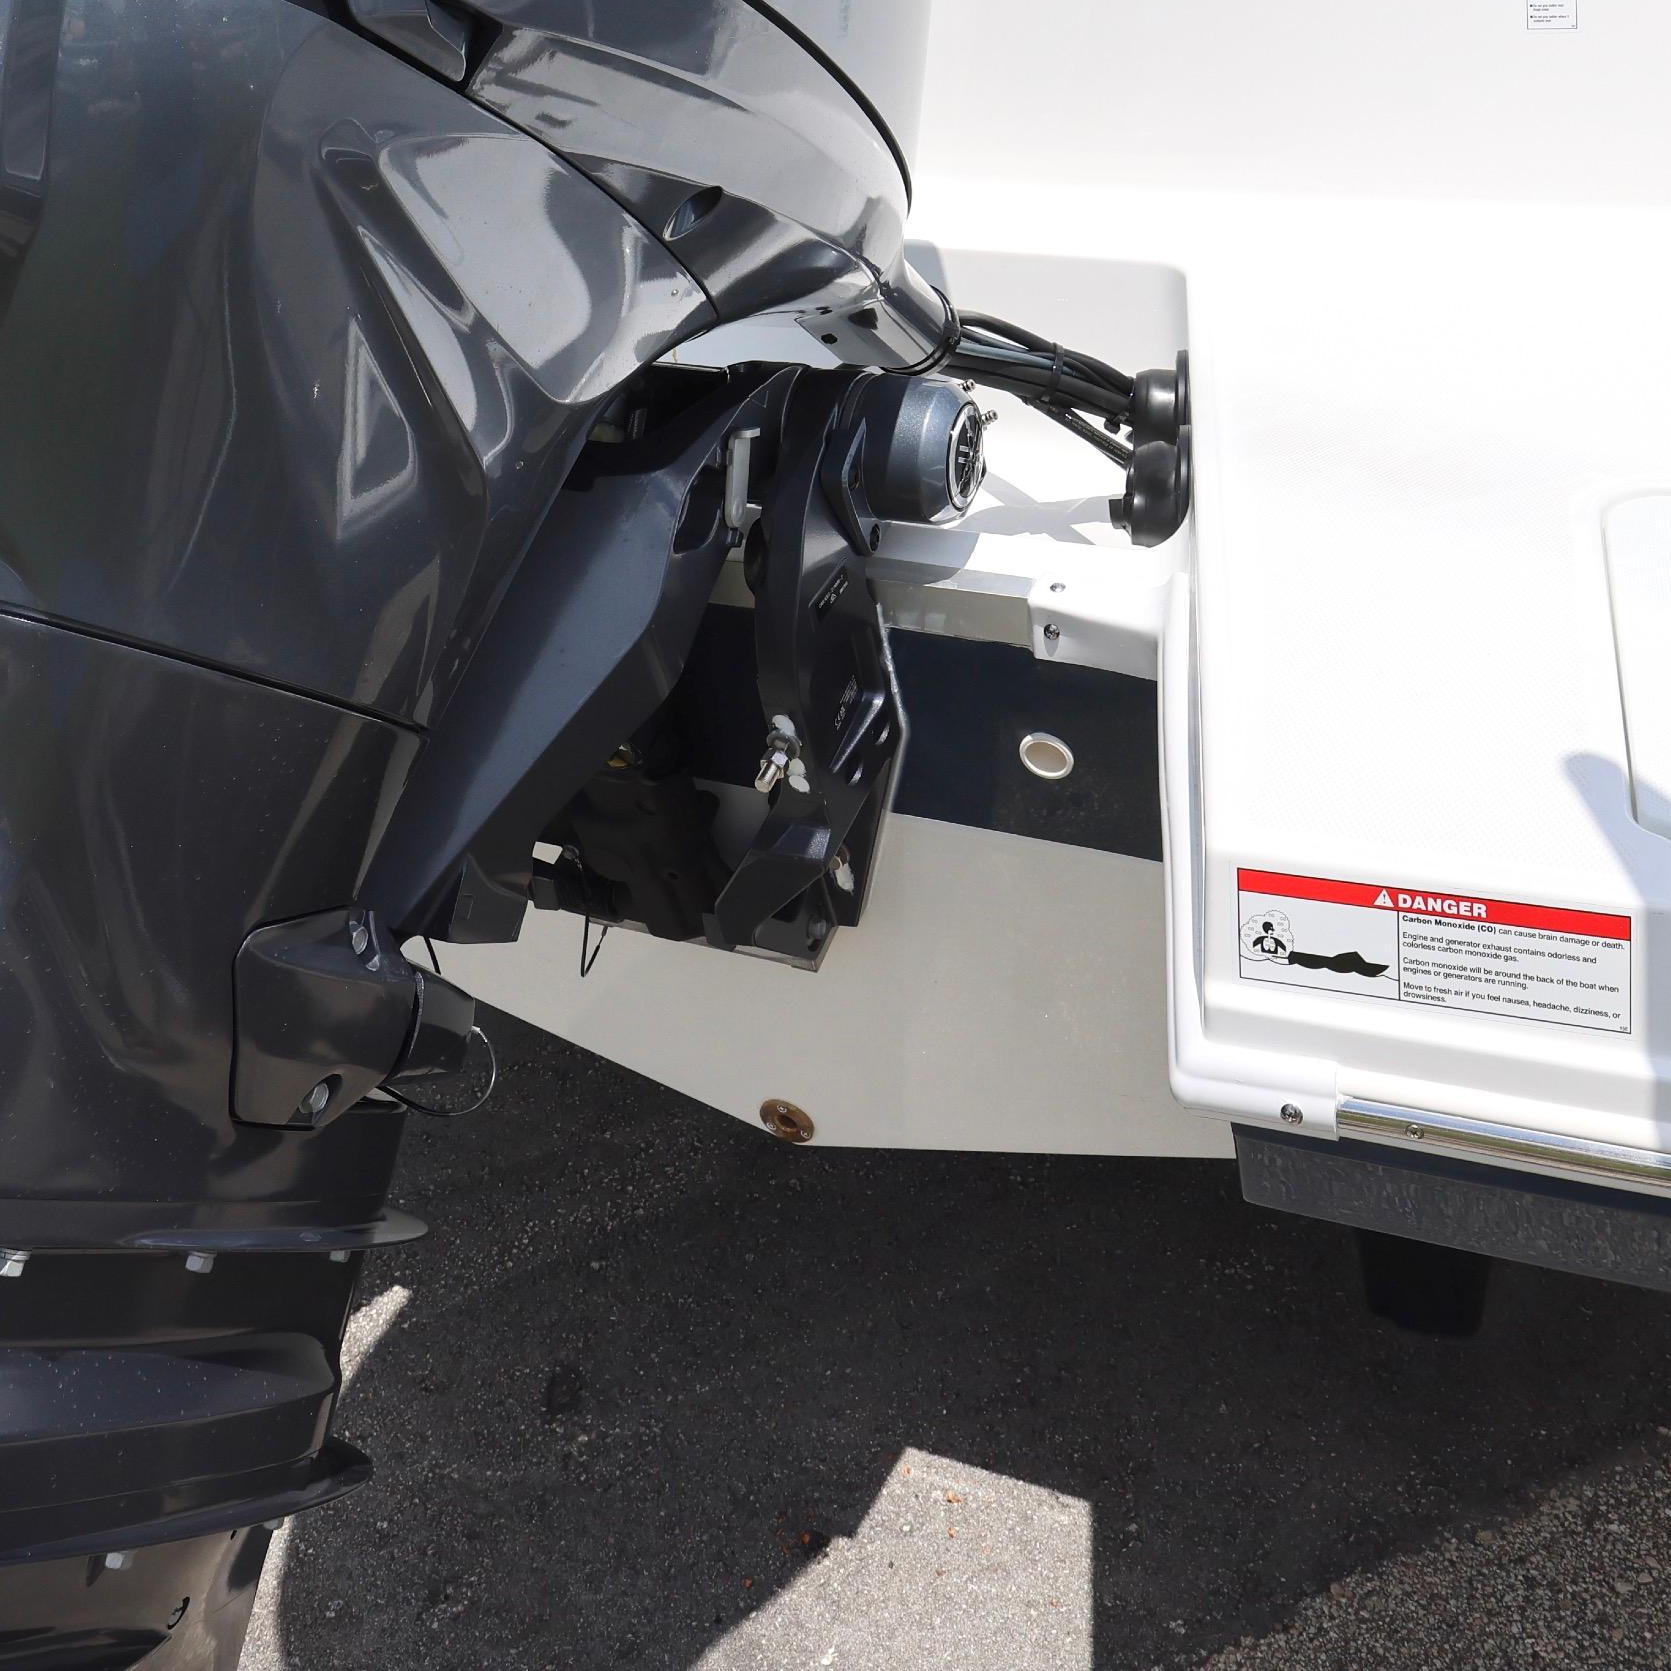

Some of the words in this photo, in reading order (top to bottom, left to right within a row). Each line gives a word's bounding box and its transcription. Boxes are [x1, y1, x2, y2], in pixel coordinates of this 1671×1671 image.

[1398, 893, 1487, 918] DANGER
[1402, 915, 1432, 924] Carbon
[1434, 919, 1476, 931] Monoxide
[1477, 924, 1496, 935] (CO)
[1514, 930, 1536, 939] cause
[1538, 932, 1558, 941] brain
[1560, 935, 1590, 946] damage
[1601, 941, 1625, 950] death.
[1402, 932, 1428, 941] Engine
[1430, 935, 1444, 944] and
[1445, 938, 1481, 948] generator
[1482, 942, 1512, 953] exhaust
[1514, 947, 1546, 957] contains
[1547, 949, 1581, 962] odorless
[1582, 956, 1597, 964] and
[1402, 941, 1436, 951] colorless
[1437, 945, 1463, 955] carbon
[1465, 949, 1502, 960] monoxide
[1503, 954, 1519, 962] gas.
[1403, 956, 1430, 967] Carbon
[1431, 961, 1468, 972] monoxide
[1469, 965, 1482, 974] will
[1483, 967, 1493, 975] be
[1494, 970, 1521, 980] around
[1522, 973, 1535, 981] the
[1536, 975, 1555, 984] back
[1565, 979, 1578, 987] the
[1579, 981, 1597, 990] boat
[1598, 983, 1619, 993] when
[1403, 966, 1432, 976] engines
[1433, 969, 1441, 977] or
[1442, 972, 1483, 983] generators
[1497, 980, 1528, 990] running.
[1403, 990, 1447, 1003] drowsiness.
[1403, 981, 1424, 991] Move
[1424, 985, 1432, 993] to
[1433, 986, 1452, 995] fresh
[1453, 989, 1463, 997] air
[1471, 992, 1485, 1000] you
[1486, 993, 1501, 1002] feel
[1502, 998, 1531, 1007] nausea,
[1532, 1000, 1572, 1013] headache,
[1573, 1006, 1610, 1019] dizziness,
